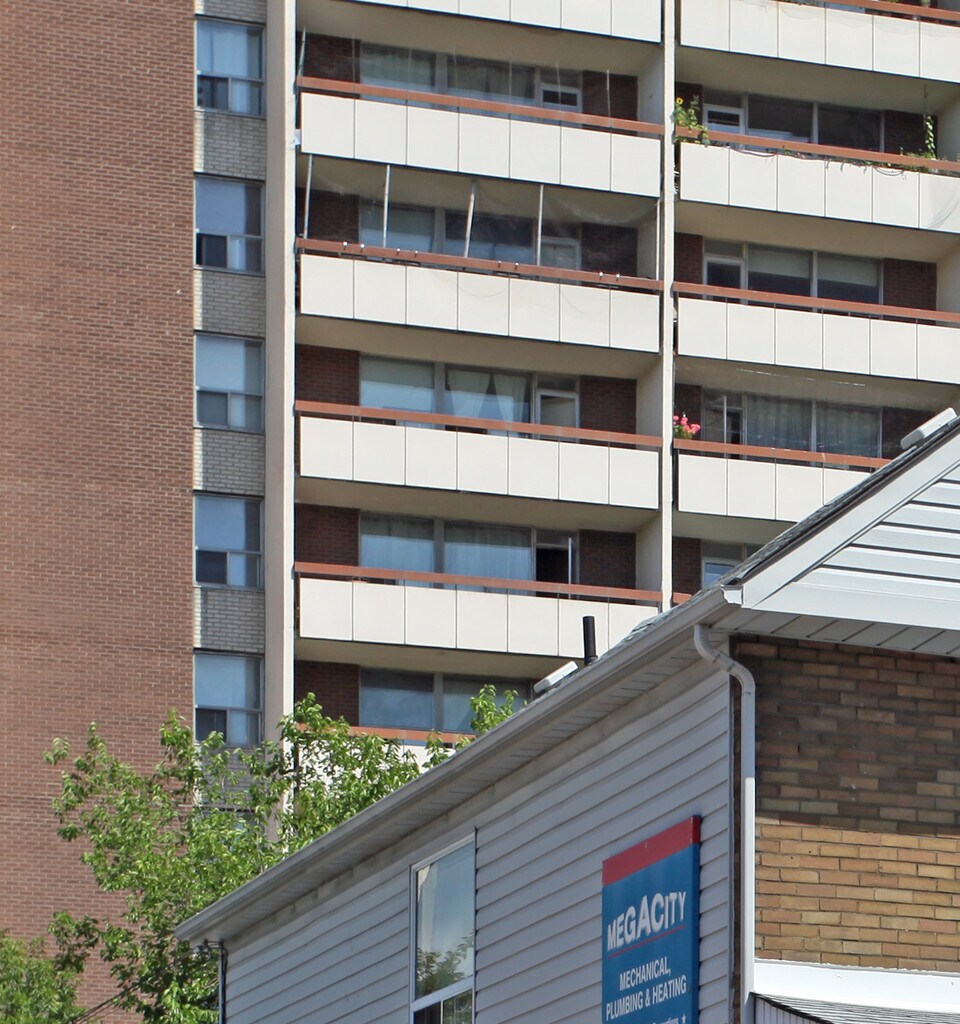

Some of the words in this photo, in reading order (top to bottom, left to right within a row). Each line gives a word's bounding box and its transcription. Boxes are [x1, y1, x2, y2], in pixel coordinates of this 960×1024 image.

[607, 891, 686, 951] MEGACITY
[620, 956, 671, 991] MECHANICAL,
[606, 991, 643, 1021] PLUMBING
[645, 988, 650, 1007] &
[653, 975, 686, 1004] HEATING
